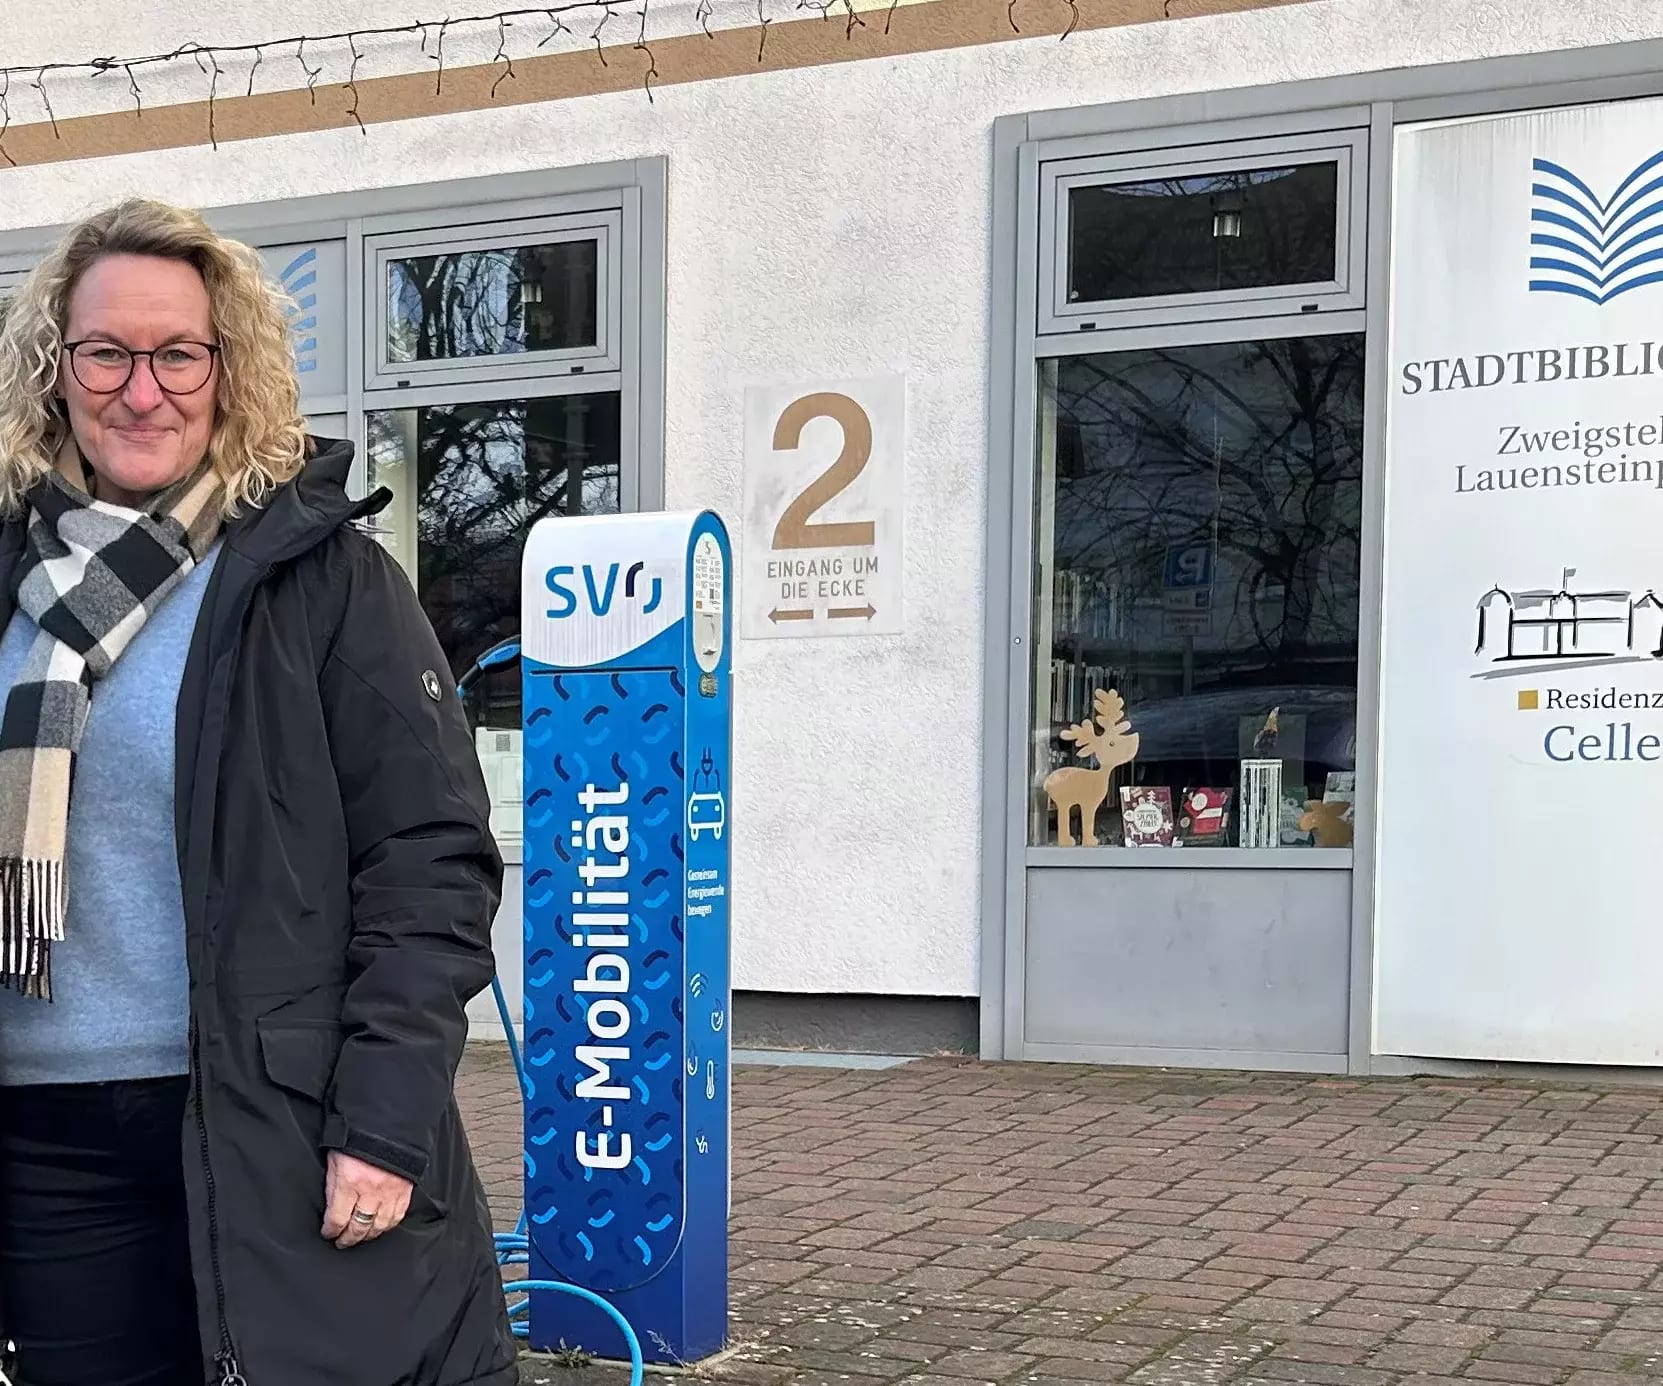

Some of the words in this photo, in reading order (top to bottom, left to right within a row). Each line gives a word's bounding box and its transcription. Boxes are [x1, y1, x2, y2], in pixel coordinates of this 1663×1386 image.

[1401, 341, 1663, 396] STADTBIBLI
[771, 392, 875, 550] 2
[544, 561, 663, 619] SVO
[767, 559, 844, 579] EINGANG
[852, 556, 879, 574] UM
[781, 582, 808, 600] DIE
[818, 579, 865, 598] ECKE
[1543, 722, 1661, 762] Celle
[572, 781, 632, 1171] E-Mobilität
